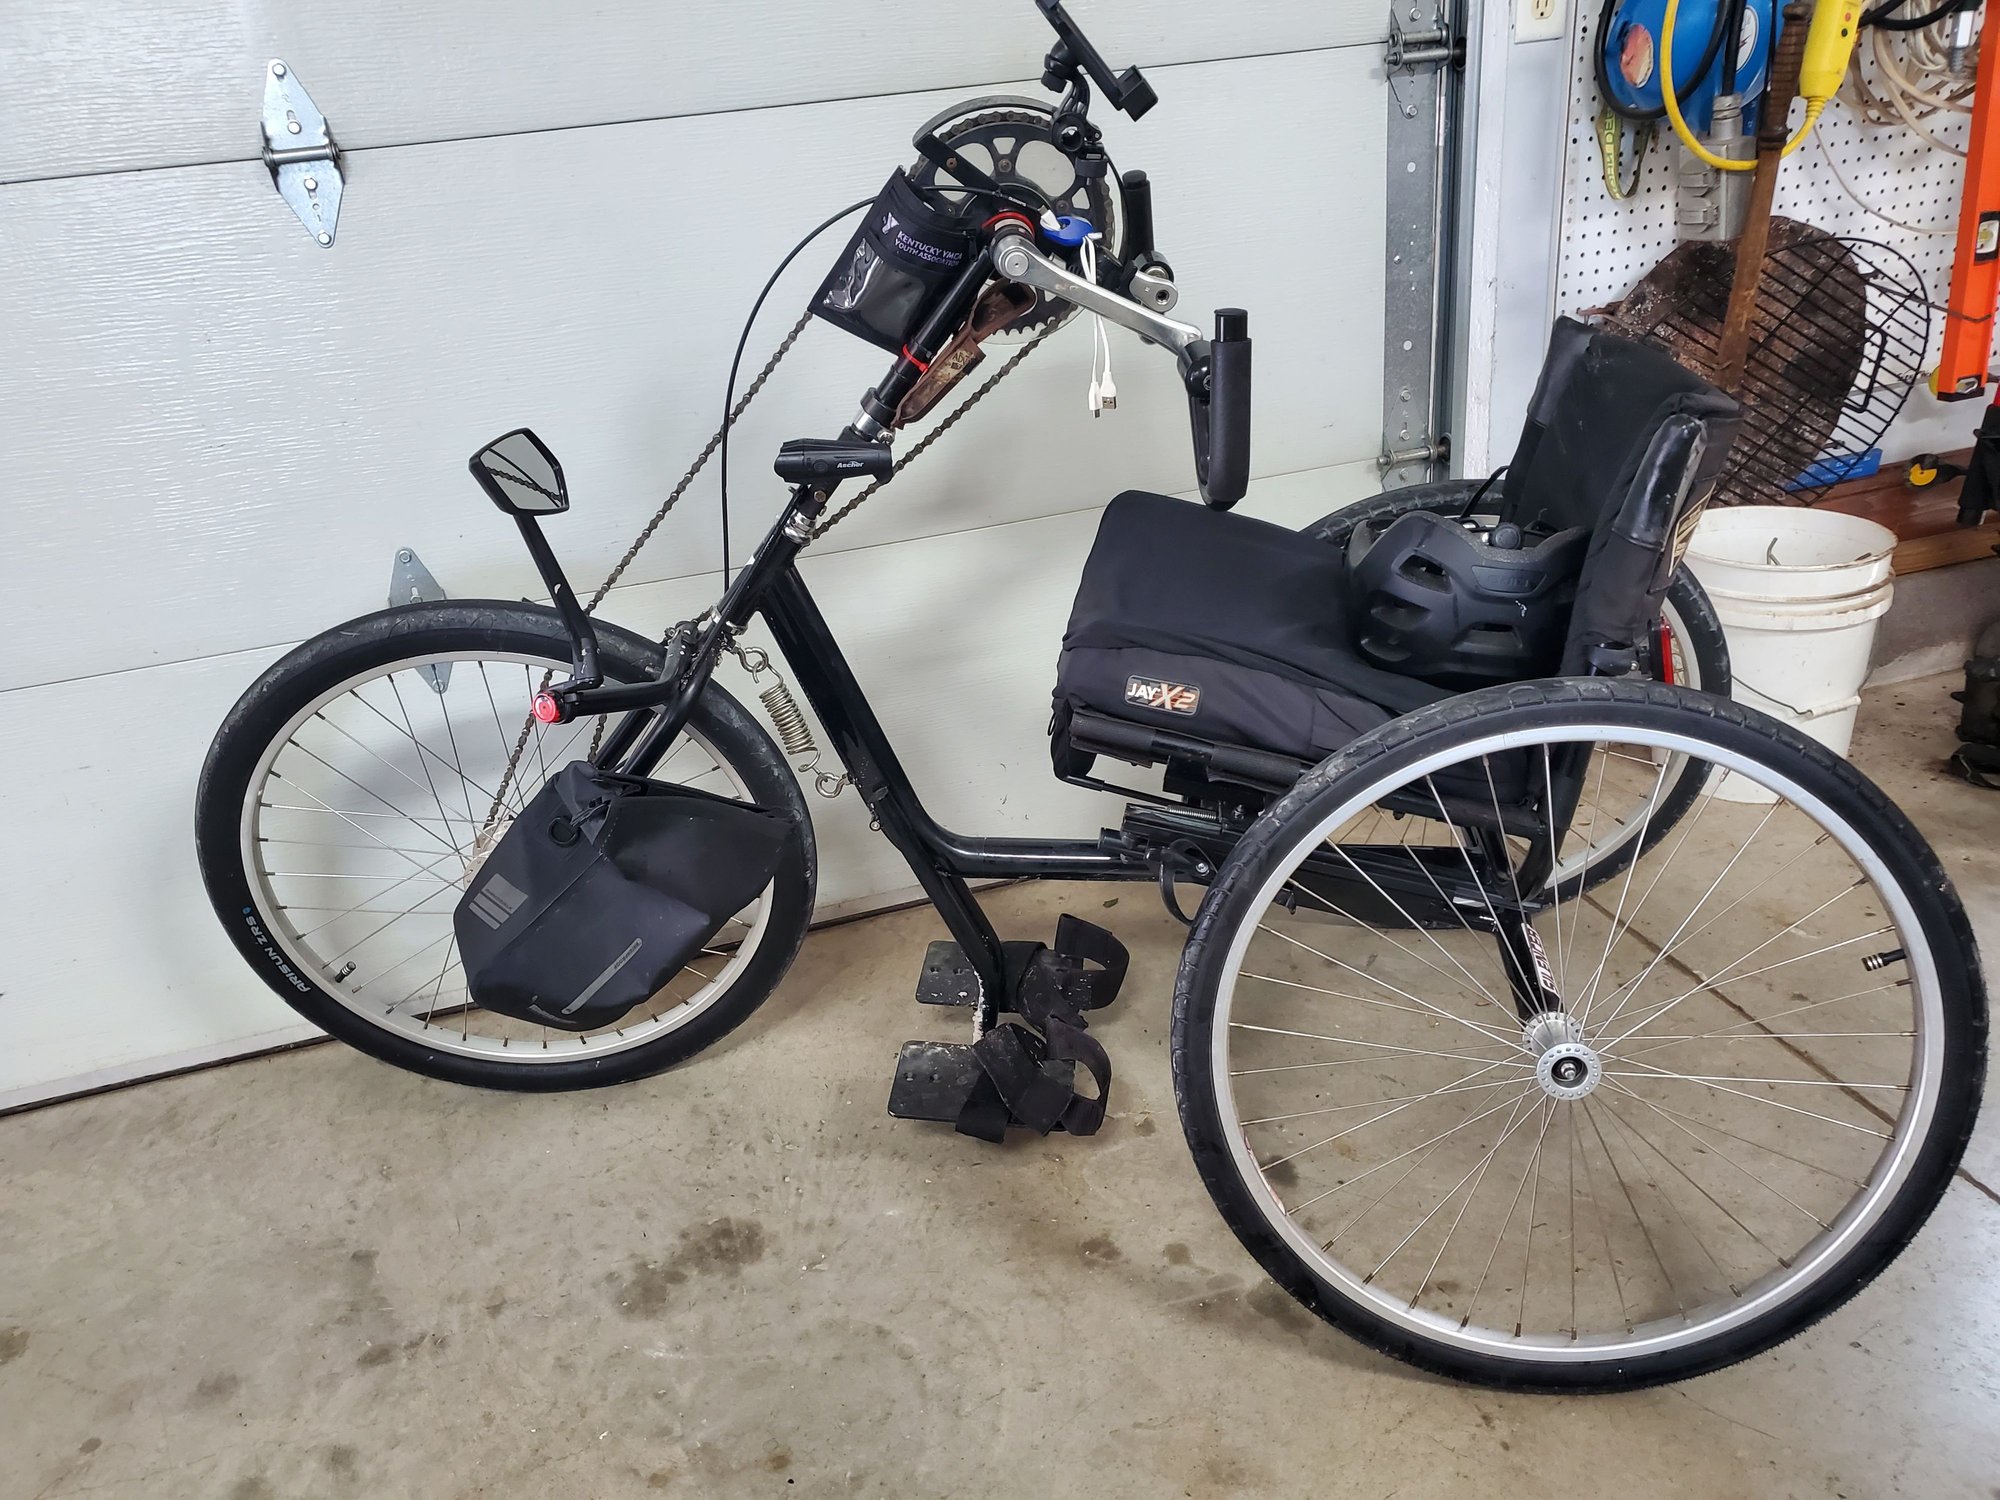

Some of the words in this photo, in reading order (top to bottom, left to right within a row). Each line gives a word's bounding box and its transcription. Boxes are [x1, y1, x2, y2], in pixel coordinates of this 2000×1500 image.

[895, 240, 918, 257] YOUTH
[897, 230, 941, 257] KENTUCKY
[942, 248, 963, 262] YMCA
[836, 460, 864, 468] Ascher
[1127, 683, 1158, 700] JAY
[1149, 683, 1196, 710] X2
[245, 915, 269, 946] ZRS
[264, 946, 312, 993] ARISUN
[1527, 927, 1556, 993] SILENCER
